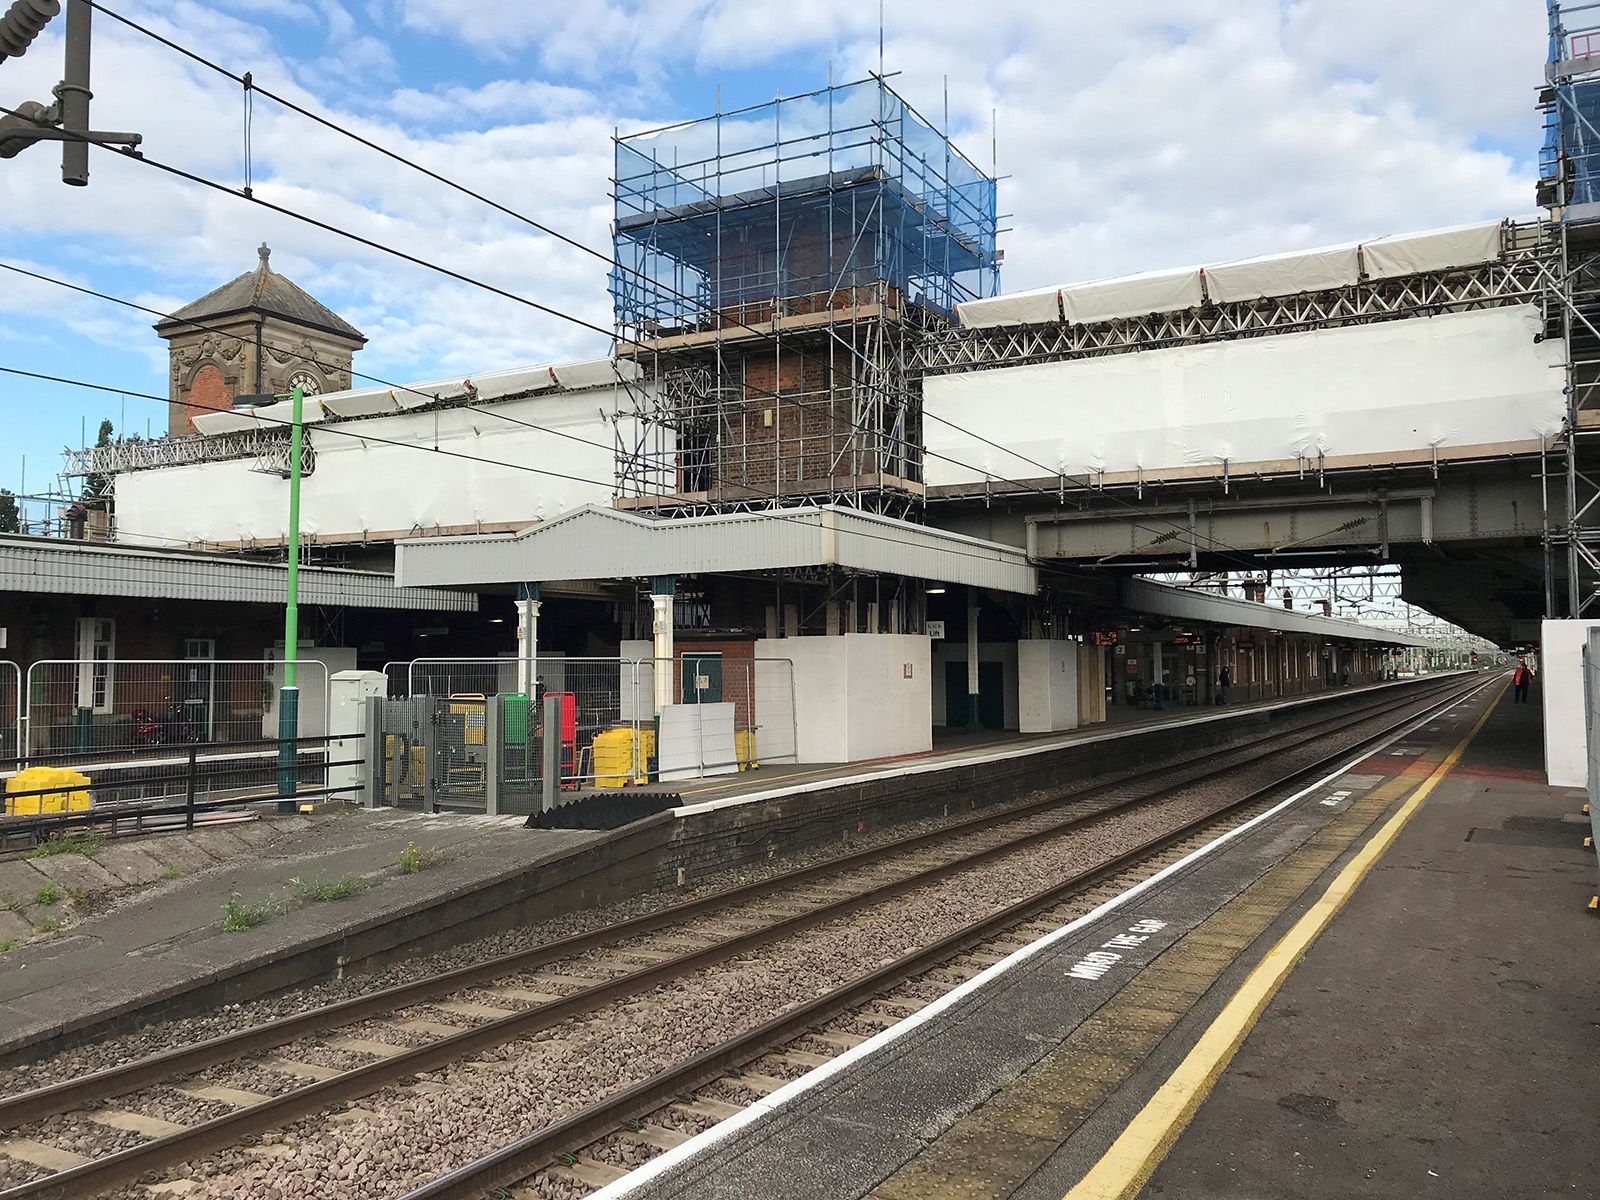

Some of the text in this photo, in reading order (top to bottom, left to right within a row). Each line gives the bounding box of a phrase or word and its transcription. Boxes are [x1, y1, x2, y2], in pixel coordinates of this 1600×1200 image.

[1063, 918, 1169, 980] MIND THE GAP
